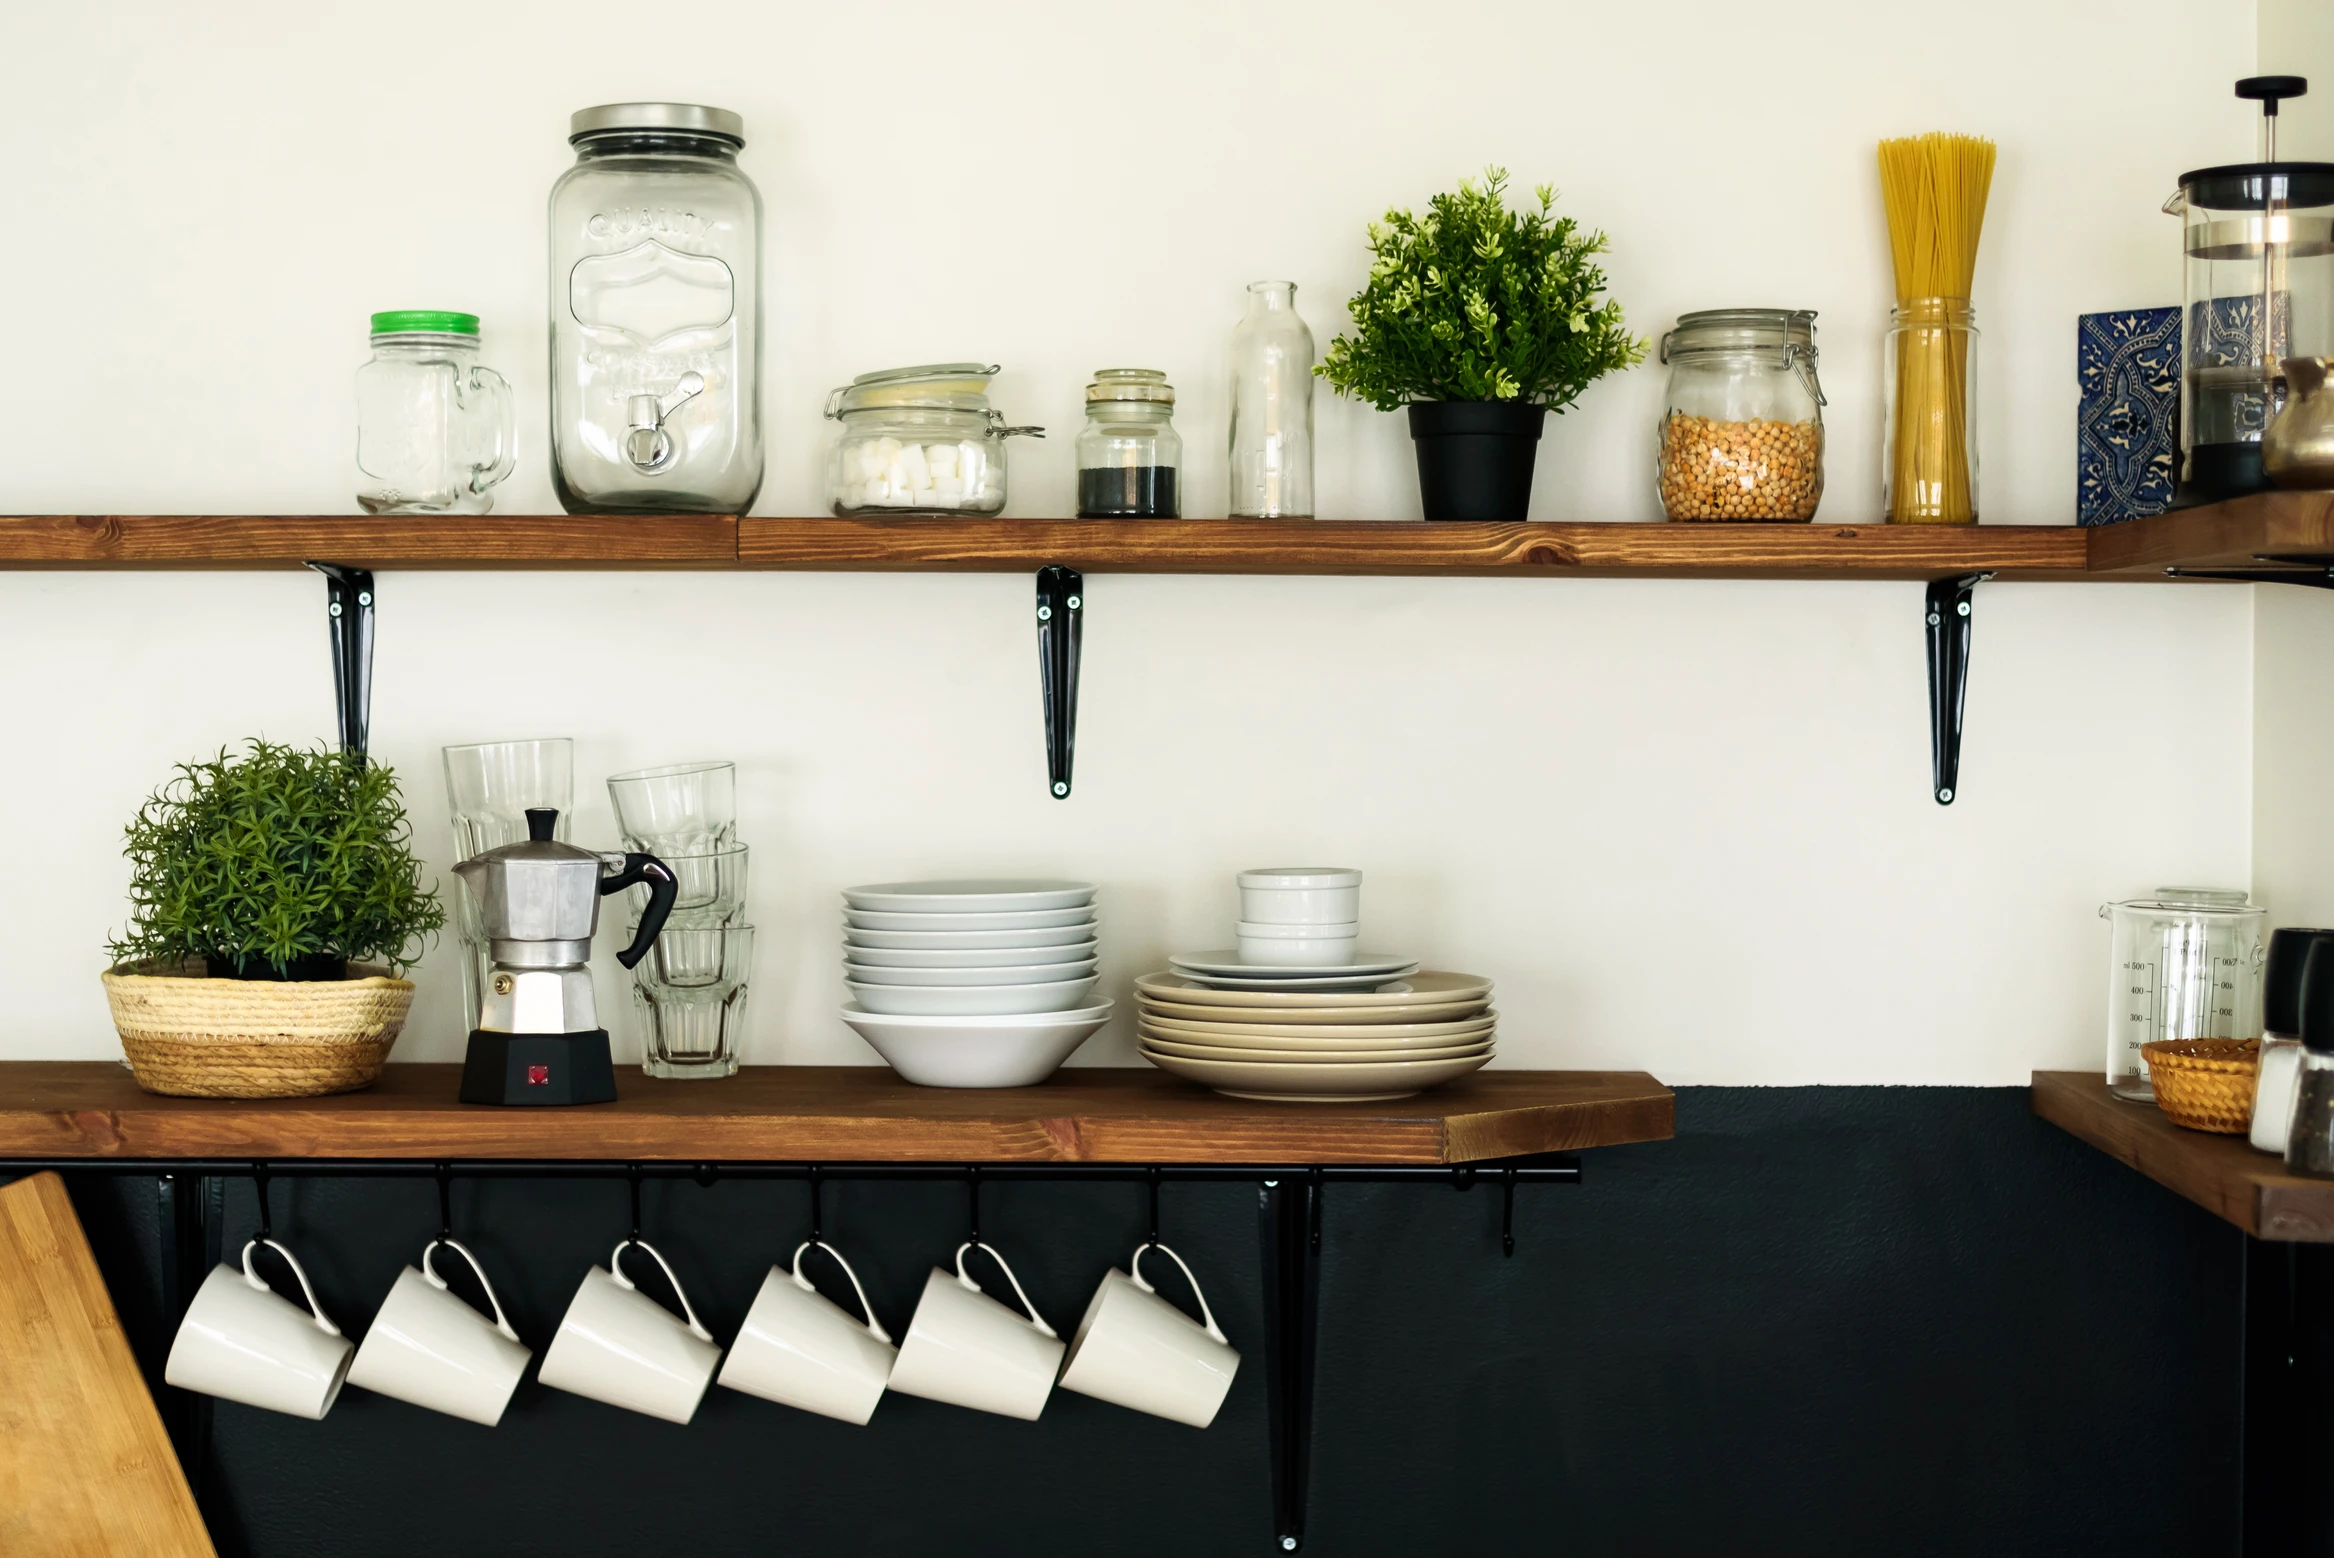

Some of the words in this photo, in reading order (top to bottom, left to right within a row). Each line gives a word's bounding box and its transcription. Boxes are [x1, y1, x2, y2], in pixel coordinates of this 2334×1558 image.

[588, 206, 717, 238] QUALITY
[2131, 961, 2145, 970] 500
[2130, 986, 2144, 994] 400
[2129, 1013, 2143, 1022] 300
[2128, 1041, 2142, 1050] 200
[2128, 1066, 2141, 1075] 100
